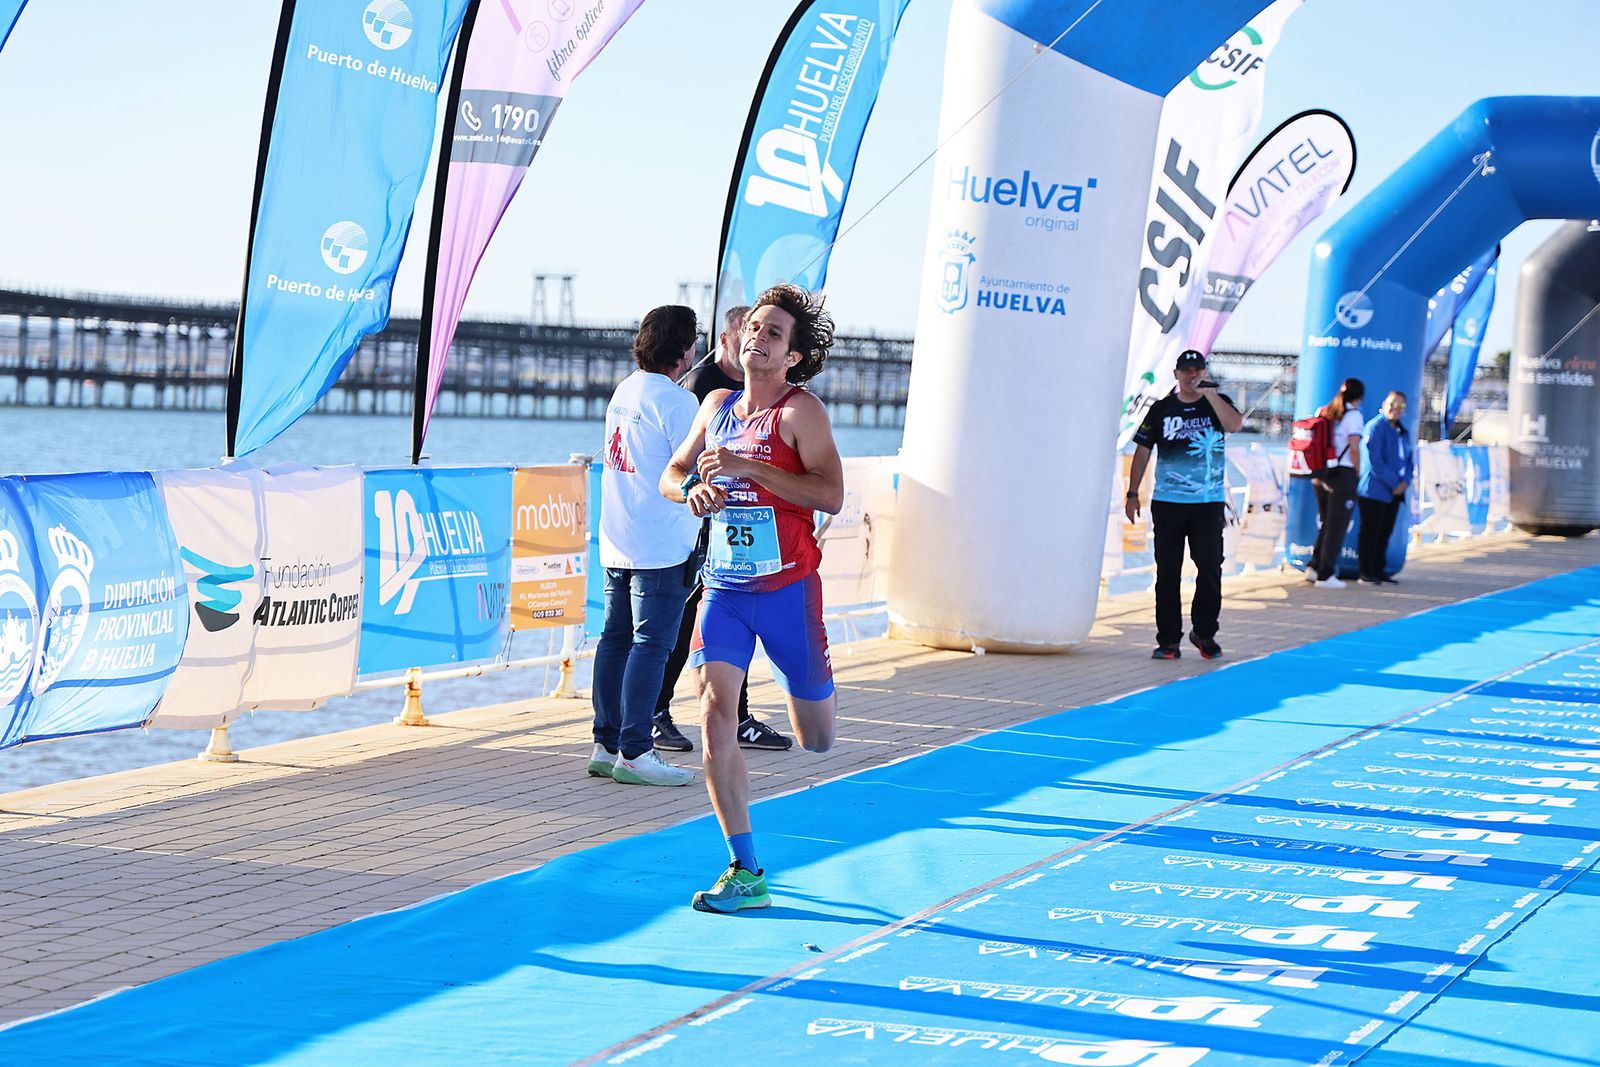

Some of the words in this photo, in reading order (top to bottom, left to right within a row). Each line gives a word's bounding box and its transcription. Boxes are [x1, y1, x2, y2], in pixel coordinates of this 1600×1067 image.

[307, 44, 363, 72] Puerto
[366, 62, 389, 78] de
[390, 66, 439, 95] Huelva
[546, 39, 577, 82] fibra
[836, 18, 872, 94] DESCUBRIMIENTO
[1205, 43, 1265, 76] CSIF
[783, 12, 858, 139] HUELVA
[491, 103, 540, 133] 1790
[833, 92, 845, 112] DEL
[819, 109, 838, 143] PUERTA
[947, 165, 1084, 213] Huelva
[1225, 137, 1334, 243] AVATEL
[1024, 214, 1080, 232] original
[1139, 137, 1217, 335] CSIF
[266, 273, 321, 297] Puerto
[325, 284, 345, 301] de
[979, 274, 1054, 294] Ayuntamiento
[1056, 281, 1070, 294] de
[976, 289, 1067, 316] HUELVA
[1307, 333, 1340, 348] Puerto
[1342, 335, 1358, 347] de
[1360, 336, 1403, 352] Huelva
[418, 511, 486, 557] HUELVA
[726, 525, 755, 547] 25
[260, 555, 332, 589] Fundación
[103, 569, 176, 611] DIPUTACIÓN
[98, 609, 174, 642] PROVINCIAL
[253, 594, 328, 627] ATLANTIC
[100, 643, 156, 671] HUELVA
[1254, 815, 1420, 836] HUELVA
[1162, 855, 1344, 879] HUELVA
[1109, 881, 1299, 906] HUELVA
[1047, 909, 1249, 936] HUELVA
[978, 943, 1188, 973] HUELVA
[899, 978, 1126, 1010] HUELVA
[806, 1020, 1052, 1055] HUELVA
